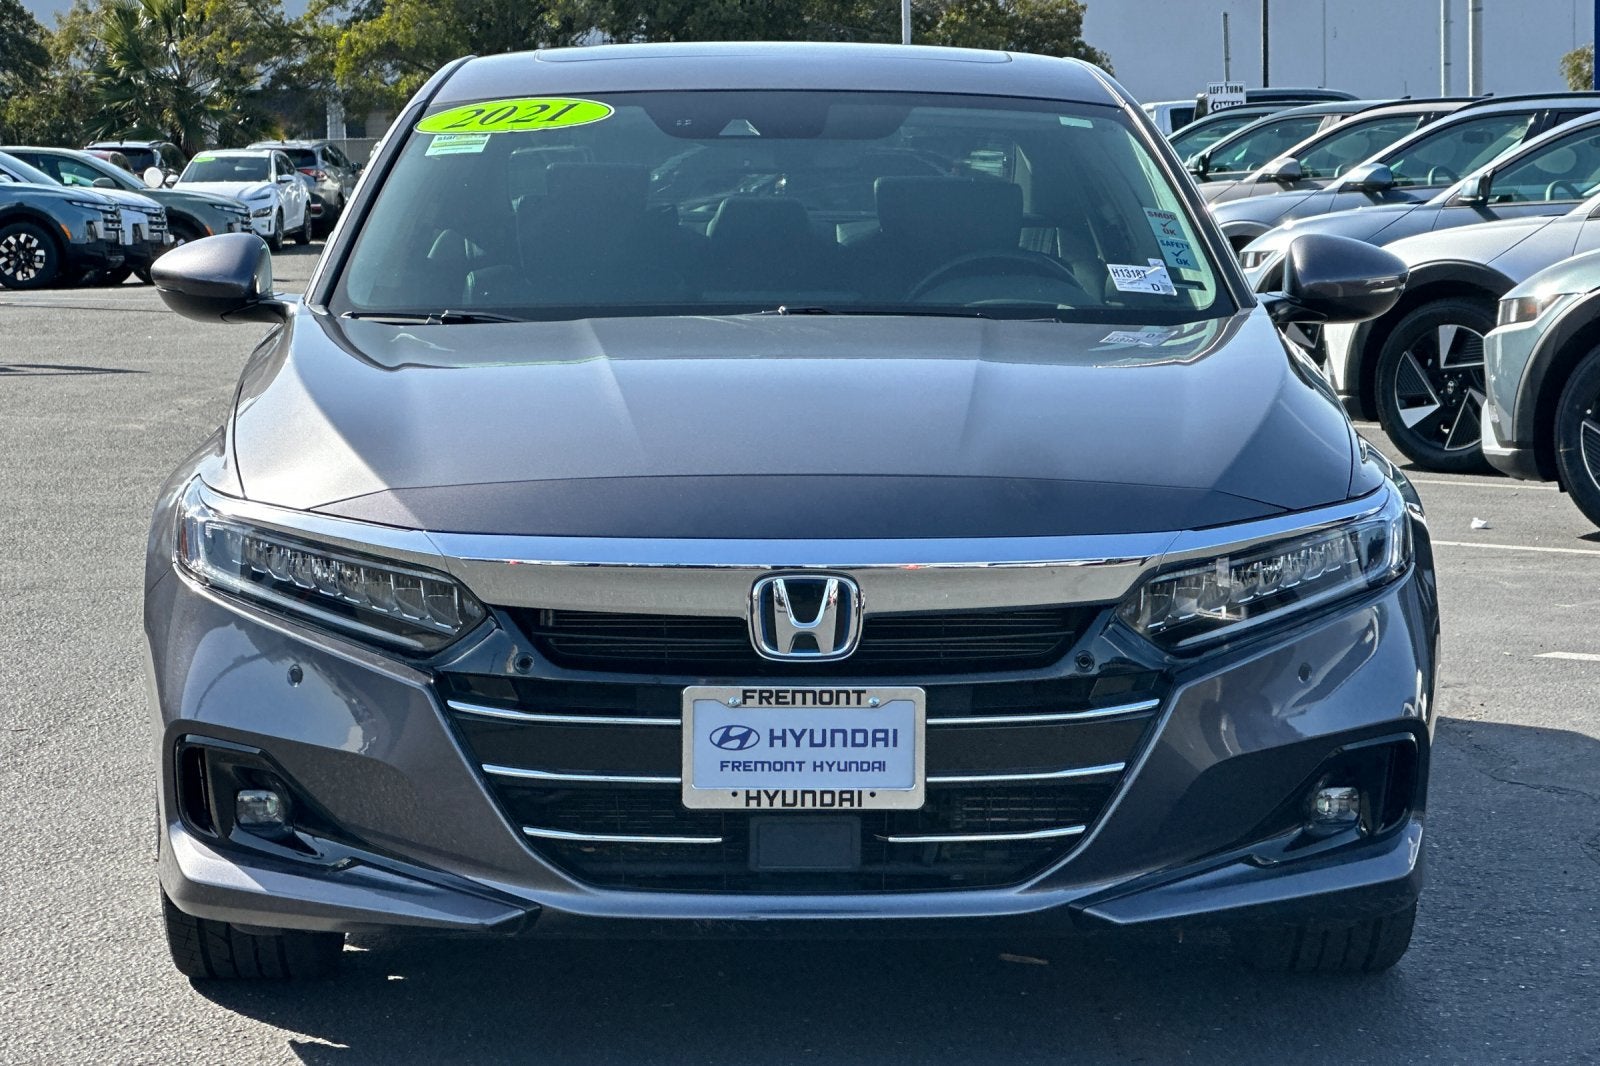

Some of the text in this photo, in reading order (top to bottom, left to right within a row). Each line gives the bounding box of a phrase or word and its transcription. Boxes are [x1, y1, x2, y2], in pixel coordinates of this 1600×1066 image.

[1209, 86, 1243, 94] LEFT TURN
[442, 103, 582, 129] 2021
[1162, 228, 1176, 236] OK
[1160, 239, 1190, 250] SAFETY
[1176, 258, 1190, 266] OK
[741, 689, 867, 706] FREMONT
[769, 728, 898, 748] HYUNDAI
[719, 760, 886, 772] FREMONT HYUNDAI
[745, 790, 863, 807] HYUNDAI
